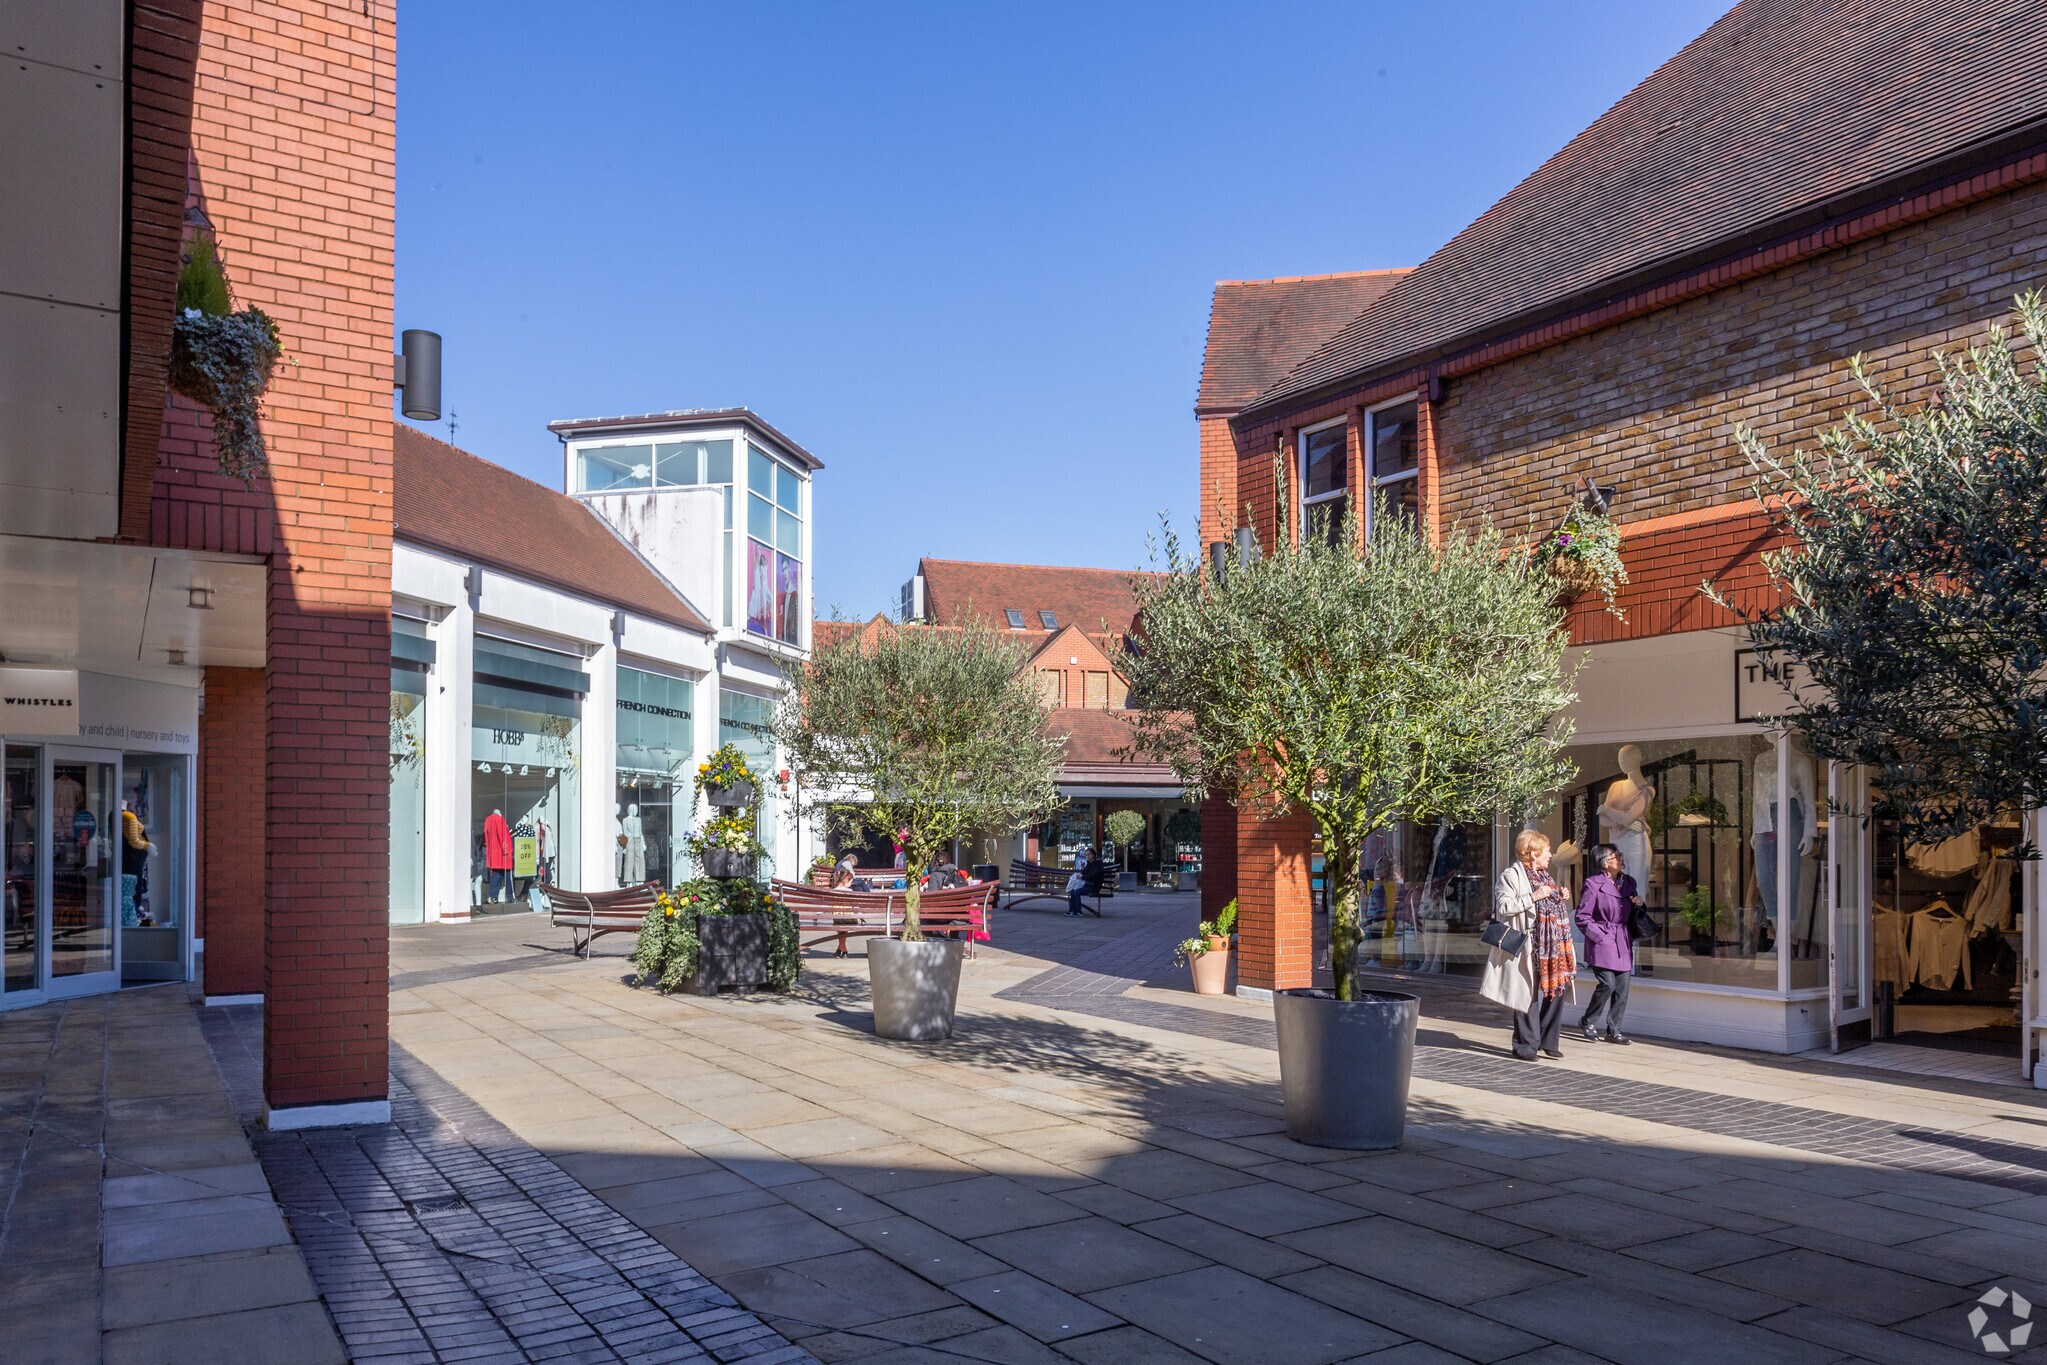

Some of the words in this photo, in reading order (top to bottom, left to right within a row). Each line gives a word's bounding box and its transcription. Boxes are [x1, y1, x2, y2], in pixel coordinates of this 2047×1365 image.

[1744, 662, 1794, 683] THE
[4, 697, 73, 707] WHISTLES
[616, 699, 646, 713] FRENCH
[647, 704, 692, 720] CONNECTION
[88, 724, 104, 736] and
[105, 726, 125, 738] child
[131, 728, 159, 743] nursery
[160, 731, 174, 743] and
[175, 733, 190, 745] toys
[493, 728, 525, 746] HOBBS
[520, 852, 532, 860] OFF
